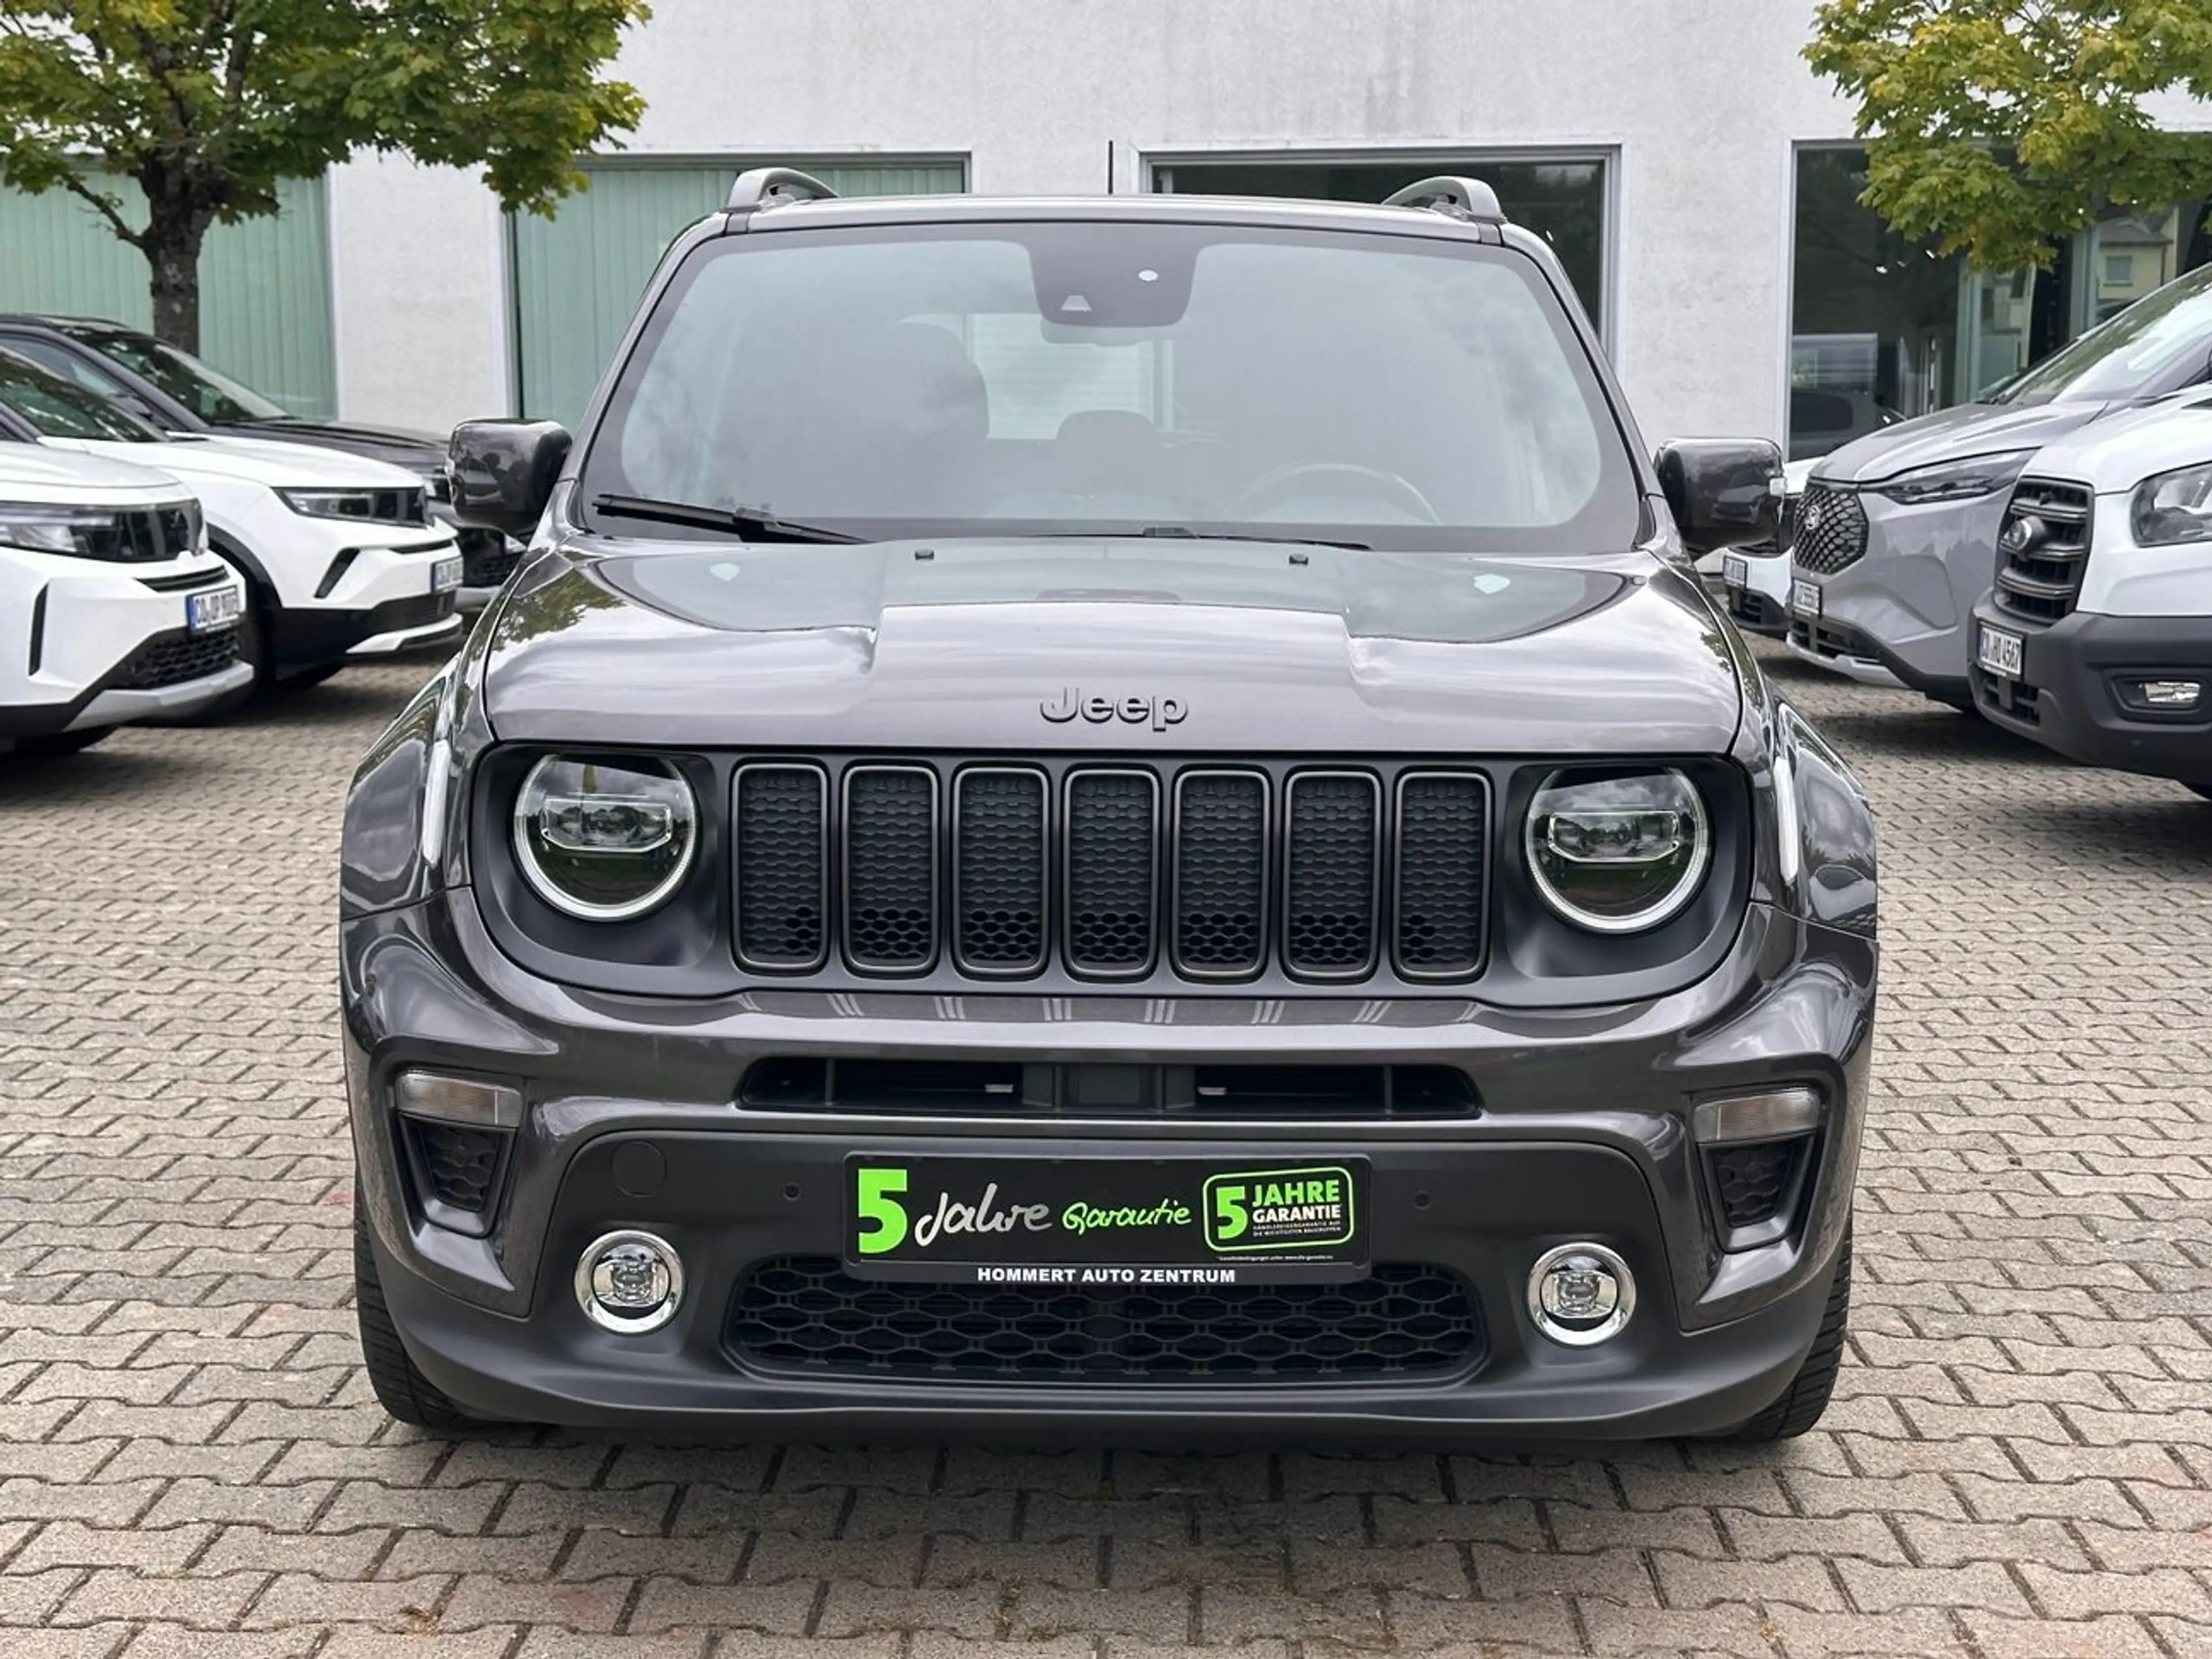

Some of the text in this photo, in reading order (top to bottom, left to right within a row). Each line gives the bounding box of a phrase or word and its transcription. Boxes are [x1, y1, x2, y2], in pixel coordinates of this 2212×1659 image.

[1039, 686, 1189, 732] Jeep
[858, 1169, 908, 1253] 5
[1216, 1179, 1340, 1240] 5 JAHRE
[978, 1267, 1236, 1283] HOMMERT AUTO ZENTRUM
